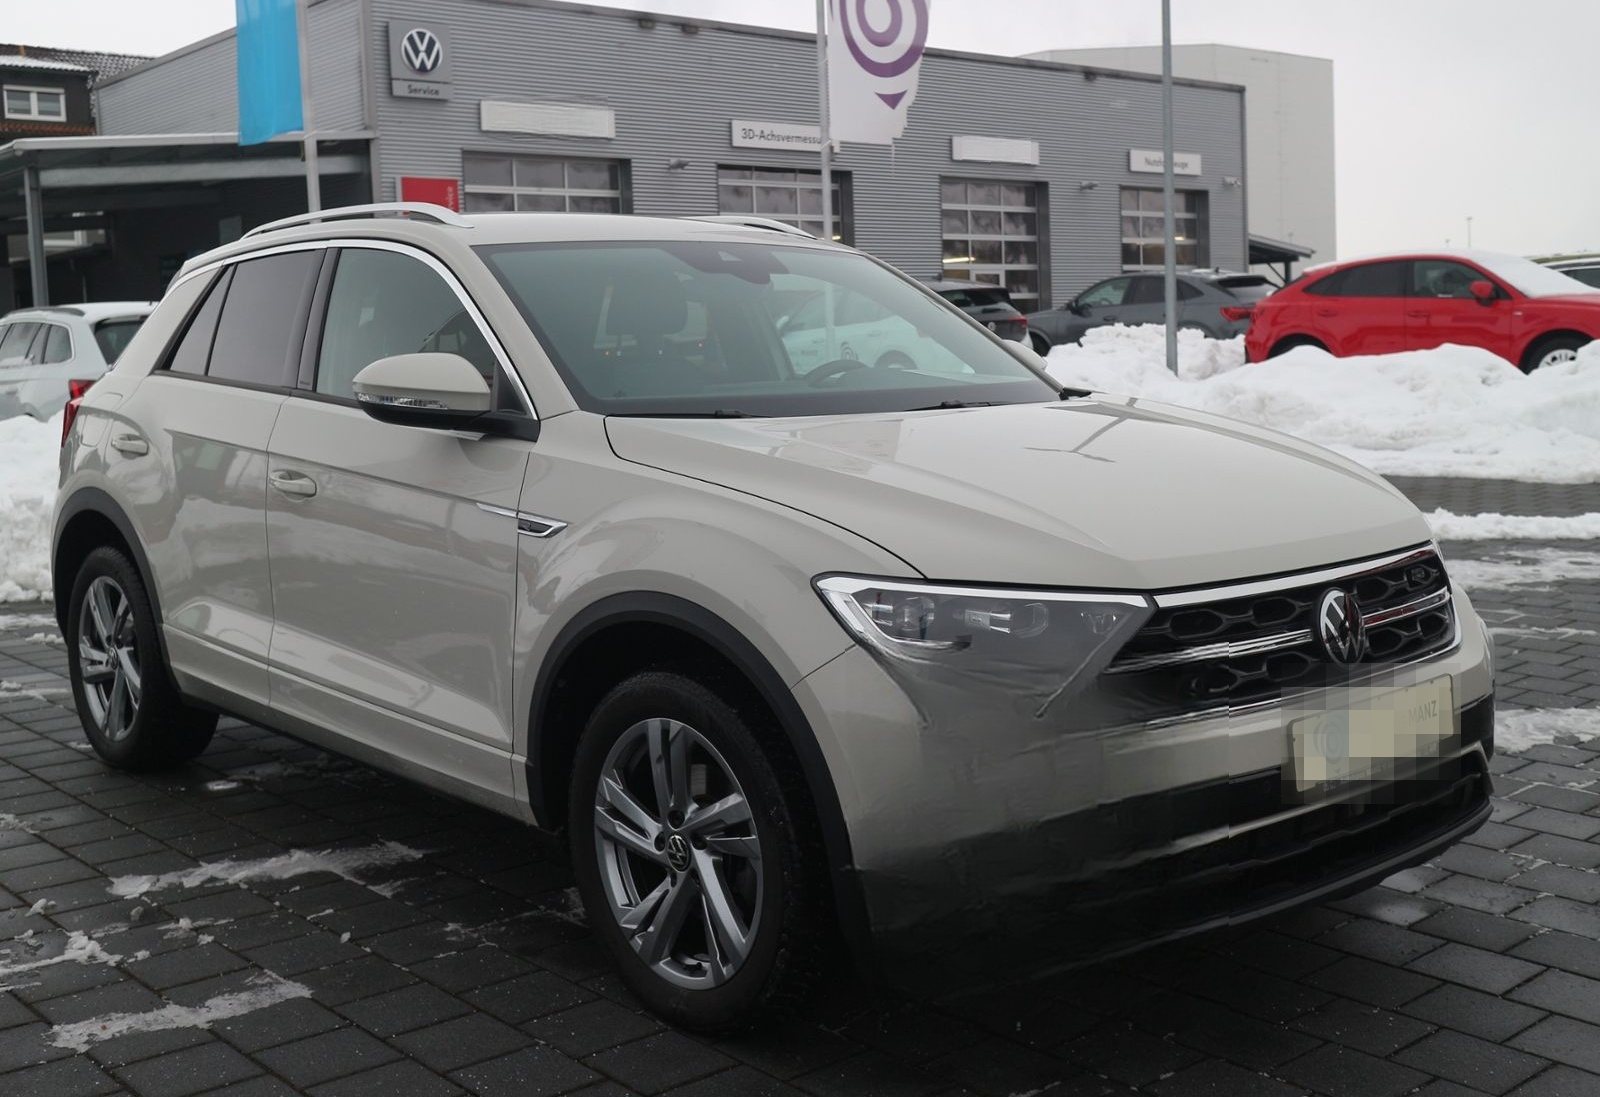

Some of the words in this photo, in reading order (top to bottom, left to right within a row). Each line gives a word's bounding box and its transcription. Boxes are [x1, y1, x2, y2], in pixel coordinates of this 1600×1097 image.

[401, 28, 442, 72] VW
[407, 84, 439, 96] Service
[741, 127, 821, 145] 3D-Achsvermessu
[1408, 699, 1438, 726] MANZ
